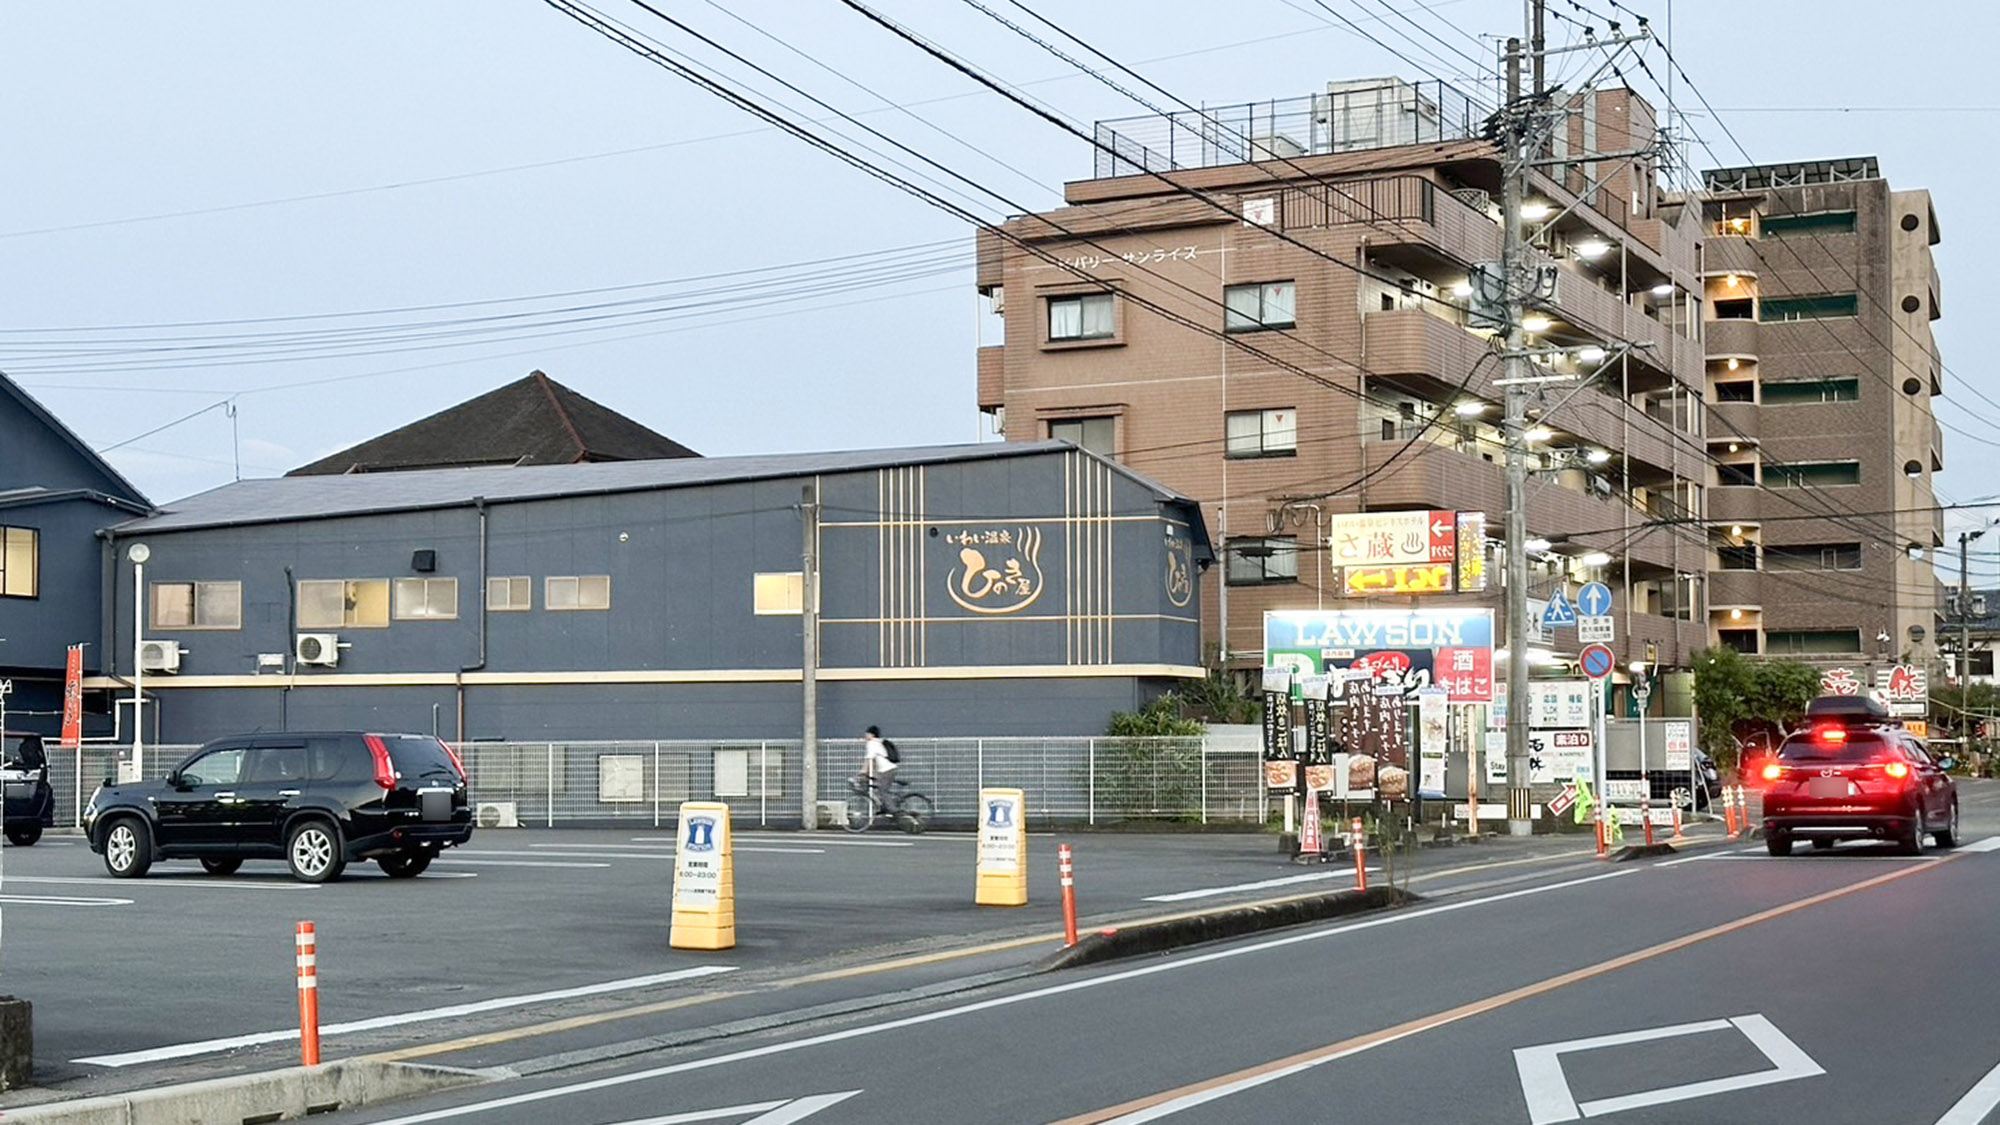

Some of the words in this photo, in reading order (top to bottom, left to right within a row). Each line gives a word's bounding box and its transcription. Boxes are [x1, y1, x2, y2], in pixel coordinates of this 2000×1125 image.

[1122, 245, 1199, 265] サンライズ
[946, 530, 1012, 545] いわい温泉
[960, 548, 1031, 598] ひのき屋
[1294, 617, 1463, 646] LAWSON
[1360, 656, 1402, 671] 手づくり
[1452, 650, 1475, 672] 酒
[1439, 676, 1488, 696] たばこ
[1556, 734, 1587, 746] 素泊り
